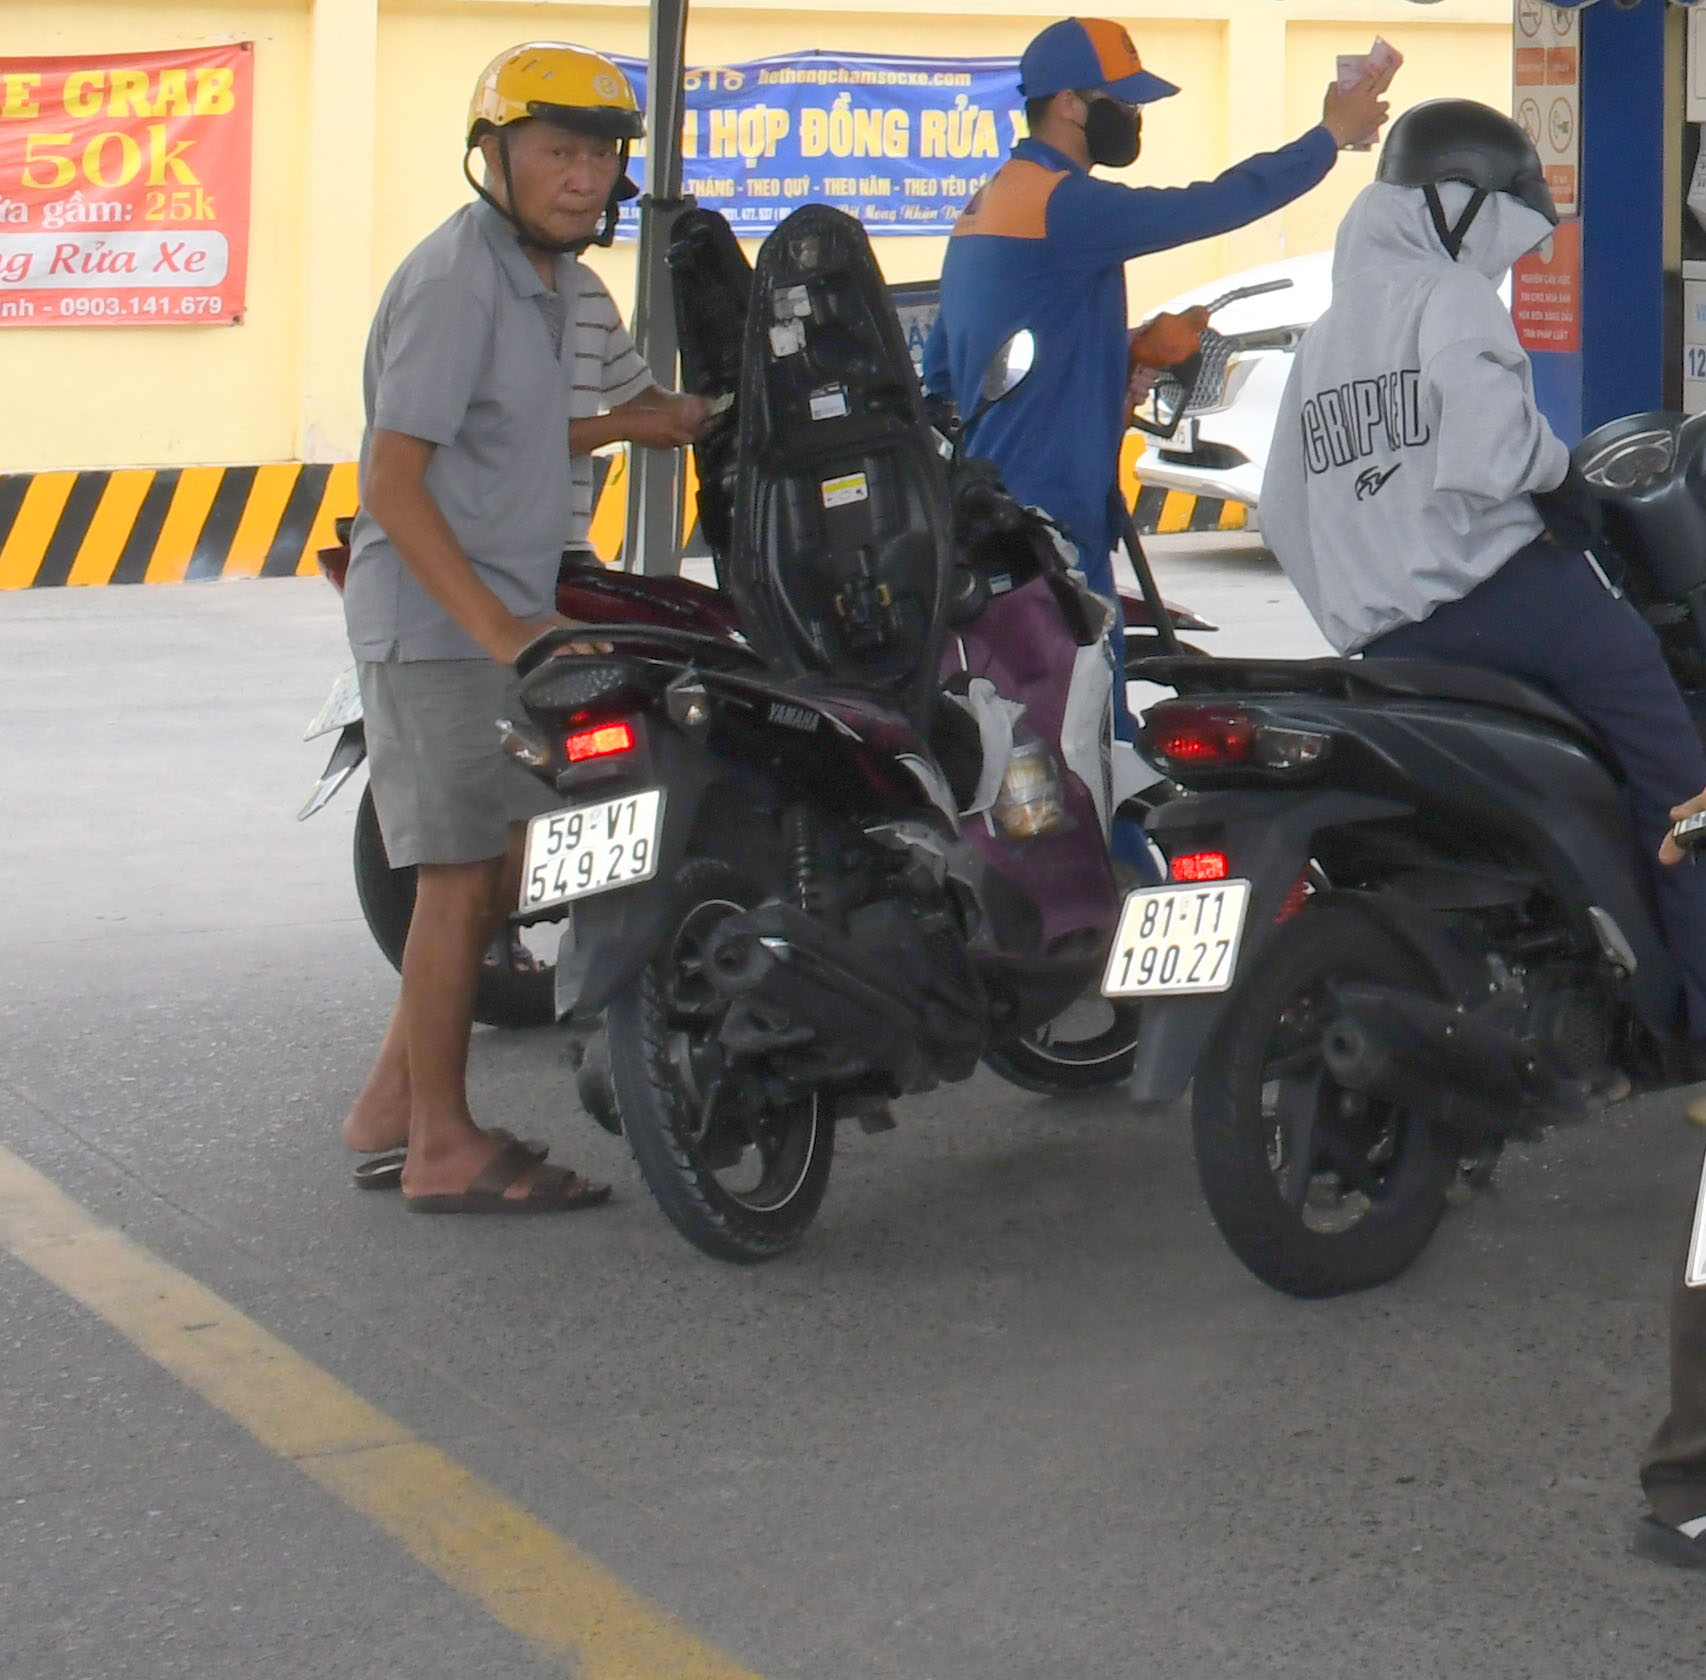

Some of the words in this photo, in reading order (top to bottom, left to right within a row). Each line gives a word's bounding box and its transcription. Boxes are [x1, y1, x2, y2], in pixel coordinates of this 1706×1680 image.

[0, 74, 41, 118] E
[64, 68, 235, 118] GRAB
[709, 104, 790, 168] HỢP
[920, 94, 999, 158] RỬA
[21, 124, 200, 189] 50k
[42, 190, 132, 230] gầm:
[145, 188, 216, 221] 25k
[747, 178, 780, 197] THEO
[823, 177, 857, 196] THEO
[904, 177, 937, 196] THEO
[0, 253, 34, 283] g
[49, 241, 138, 275] Rửa
[153, 242, 207, 274] Xe
[60, 296, 222, 317] 0903.141.679
[1689, 348, 1706, 377] 12
[547, 801, 638, 850] 59-V1
[530, 840, 648, 906] 549.29
[1139, 897, 1223, 940] 81-T1
[1120, 939, 1230, 989] 190.27
